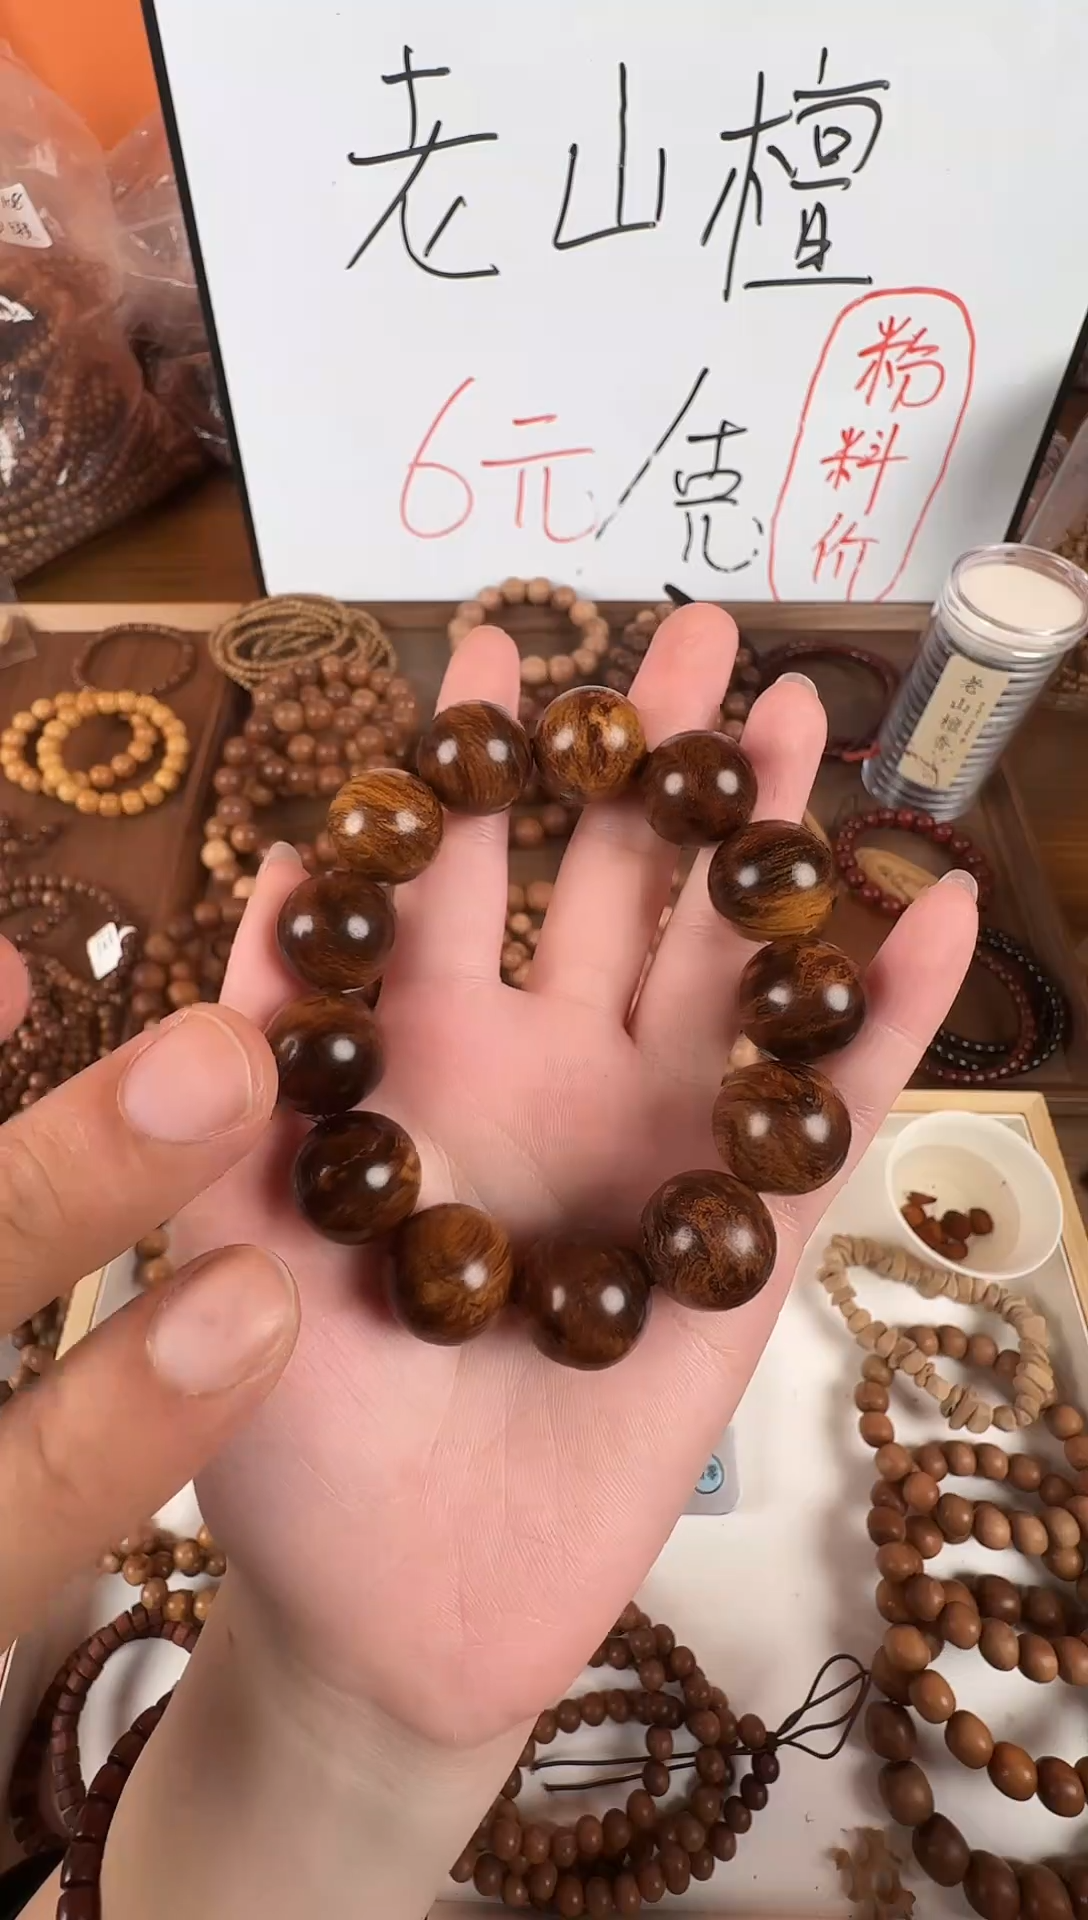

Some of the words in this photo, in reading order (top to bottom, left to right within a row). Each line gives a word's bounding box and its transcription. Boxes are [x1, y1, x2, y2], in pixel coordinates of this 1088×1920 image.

[346, 45, 889, 301] 老山檀
[399, 367, 763, 573] 6元/克
[811, 315, 945, 600] 粉料价
